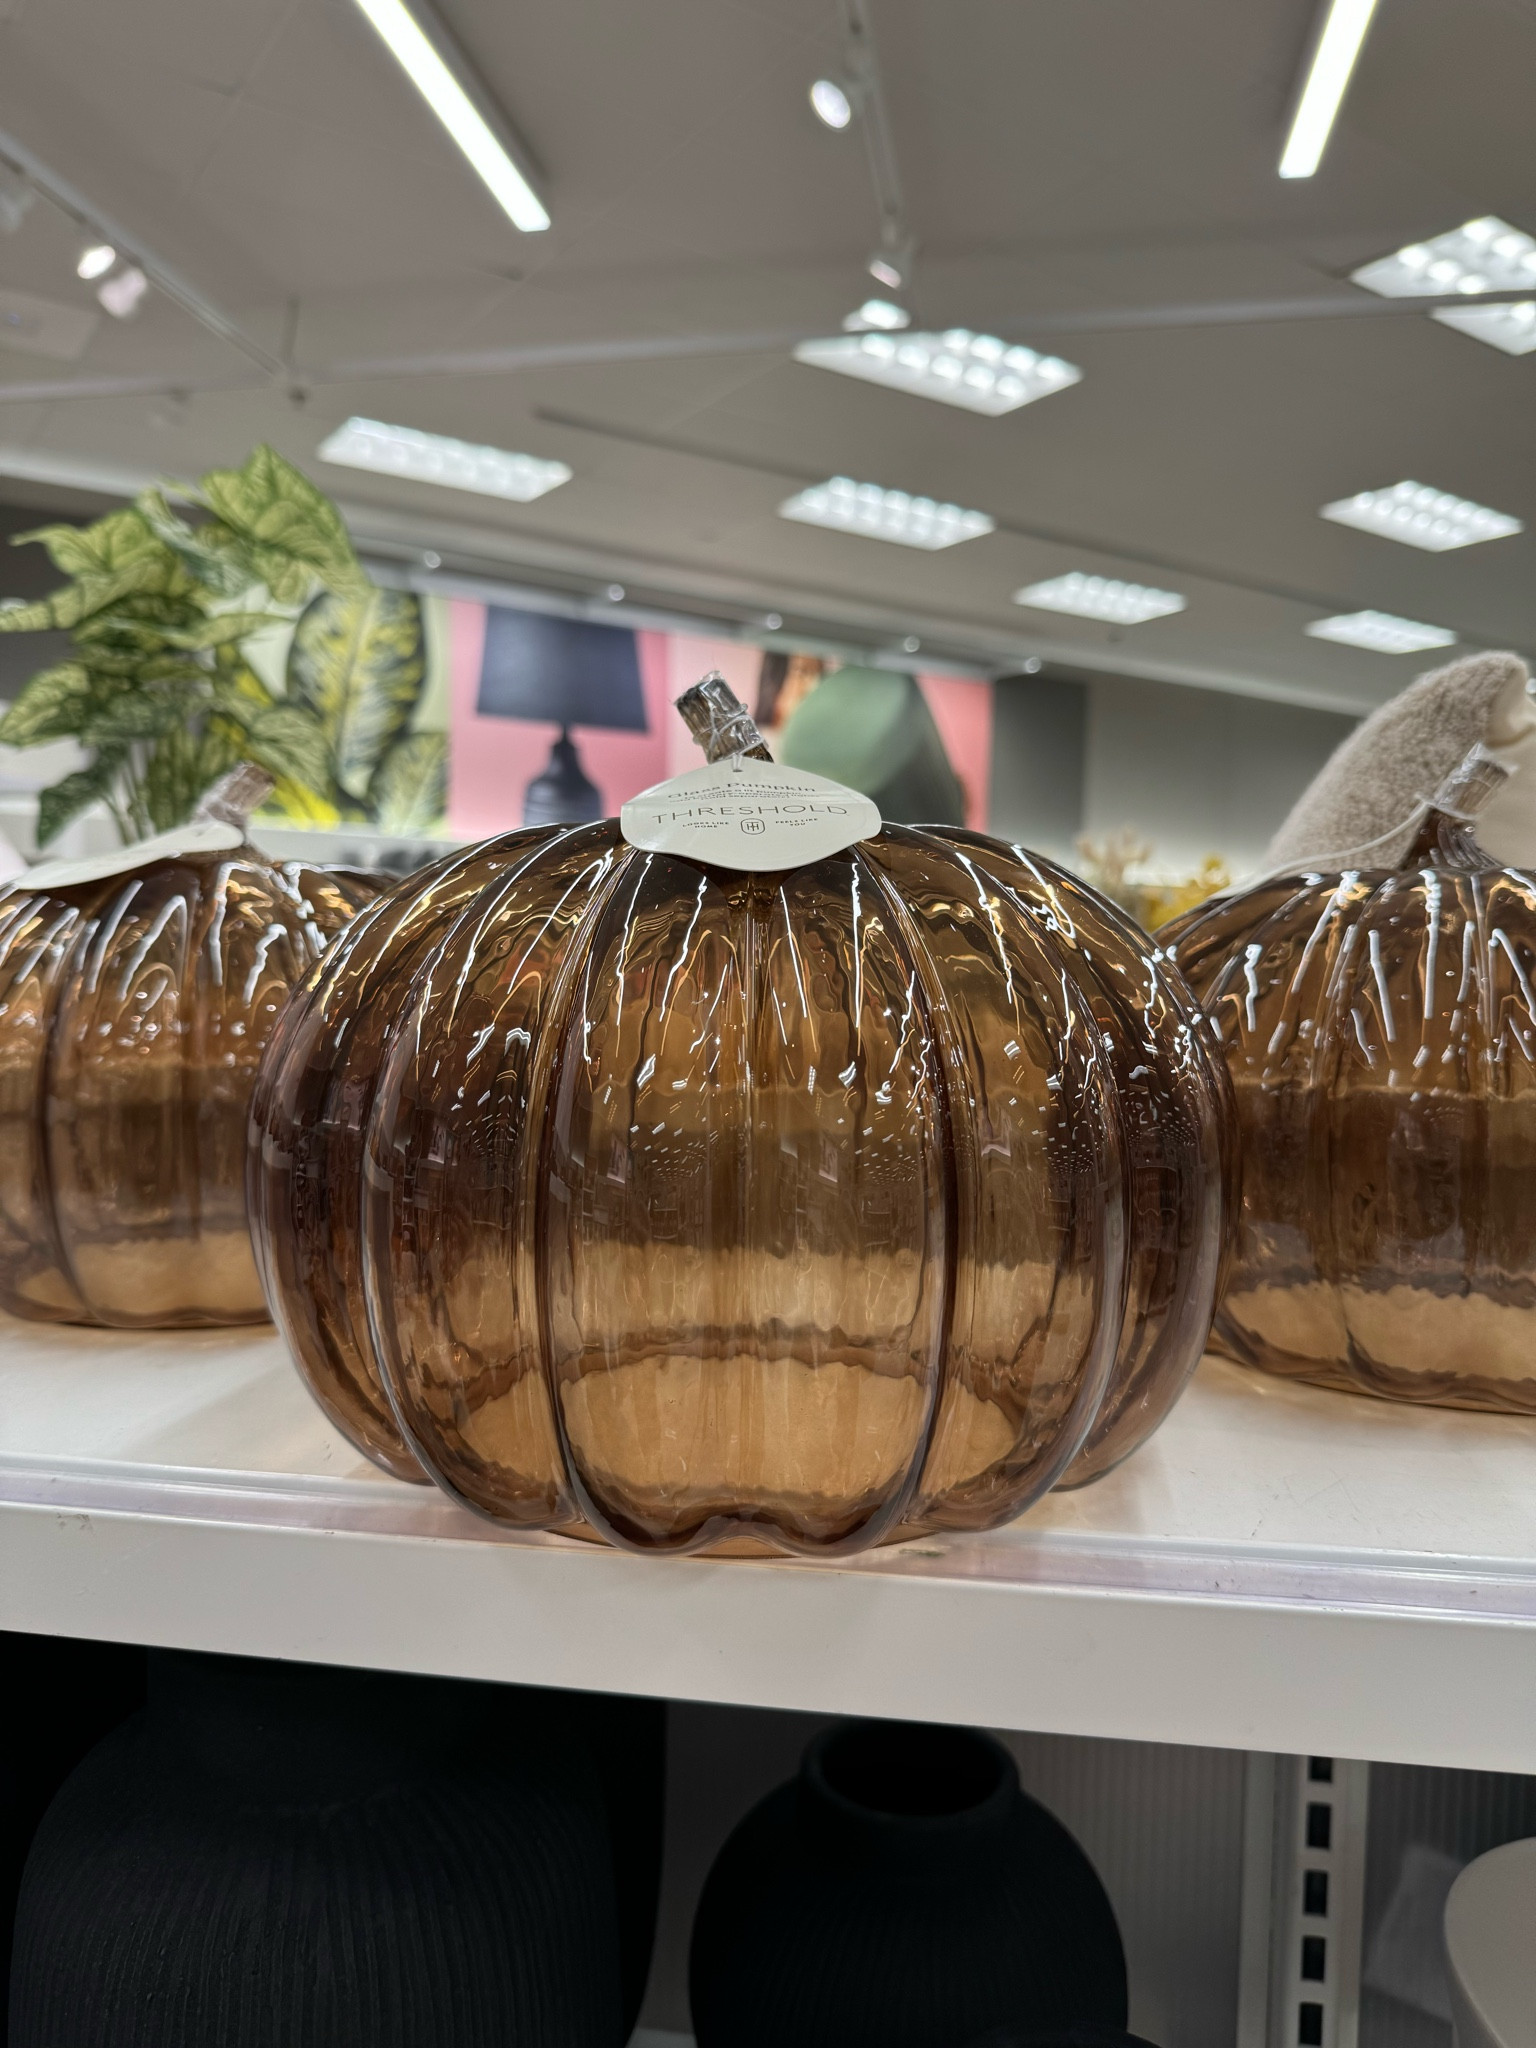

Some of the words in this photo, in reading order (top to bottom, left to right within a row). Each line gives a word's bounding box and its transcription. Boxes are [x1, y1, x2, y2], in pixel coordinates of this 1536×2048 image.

[668, 786, 721, 798] Glass
[727, 783, 815, 792] Pumpkin
[652, 804, 847, 824] THRESHOLD
